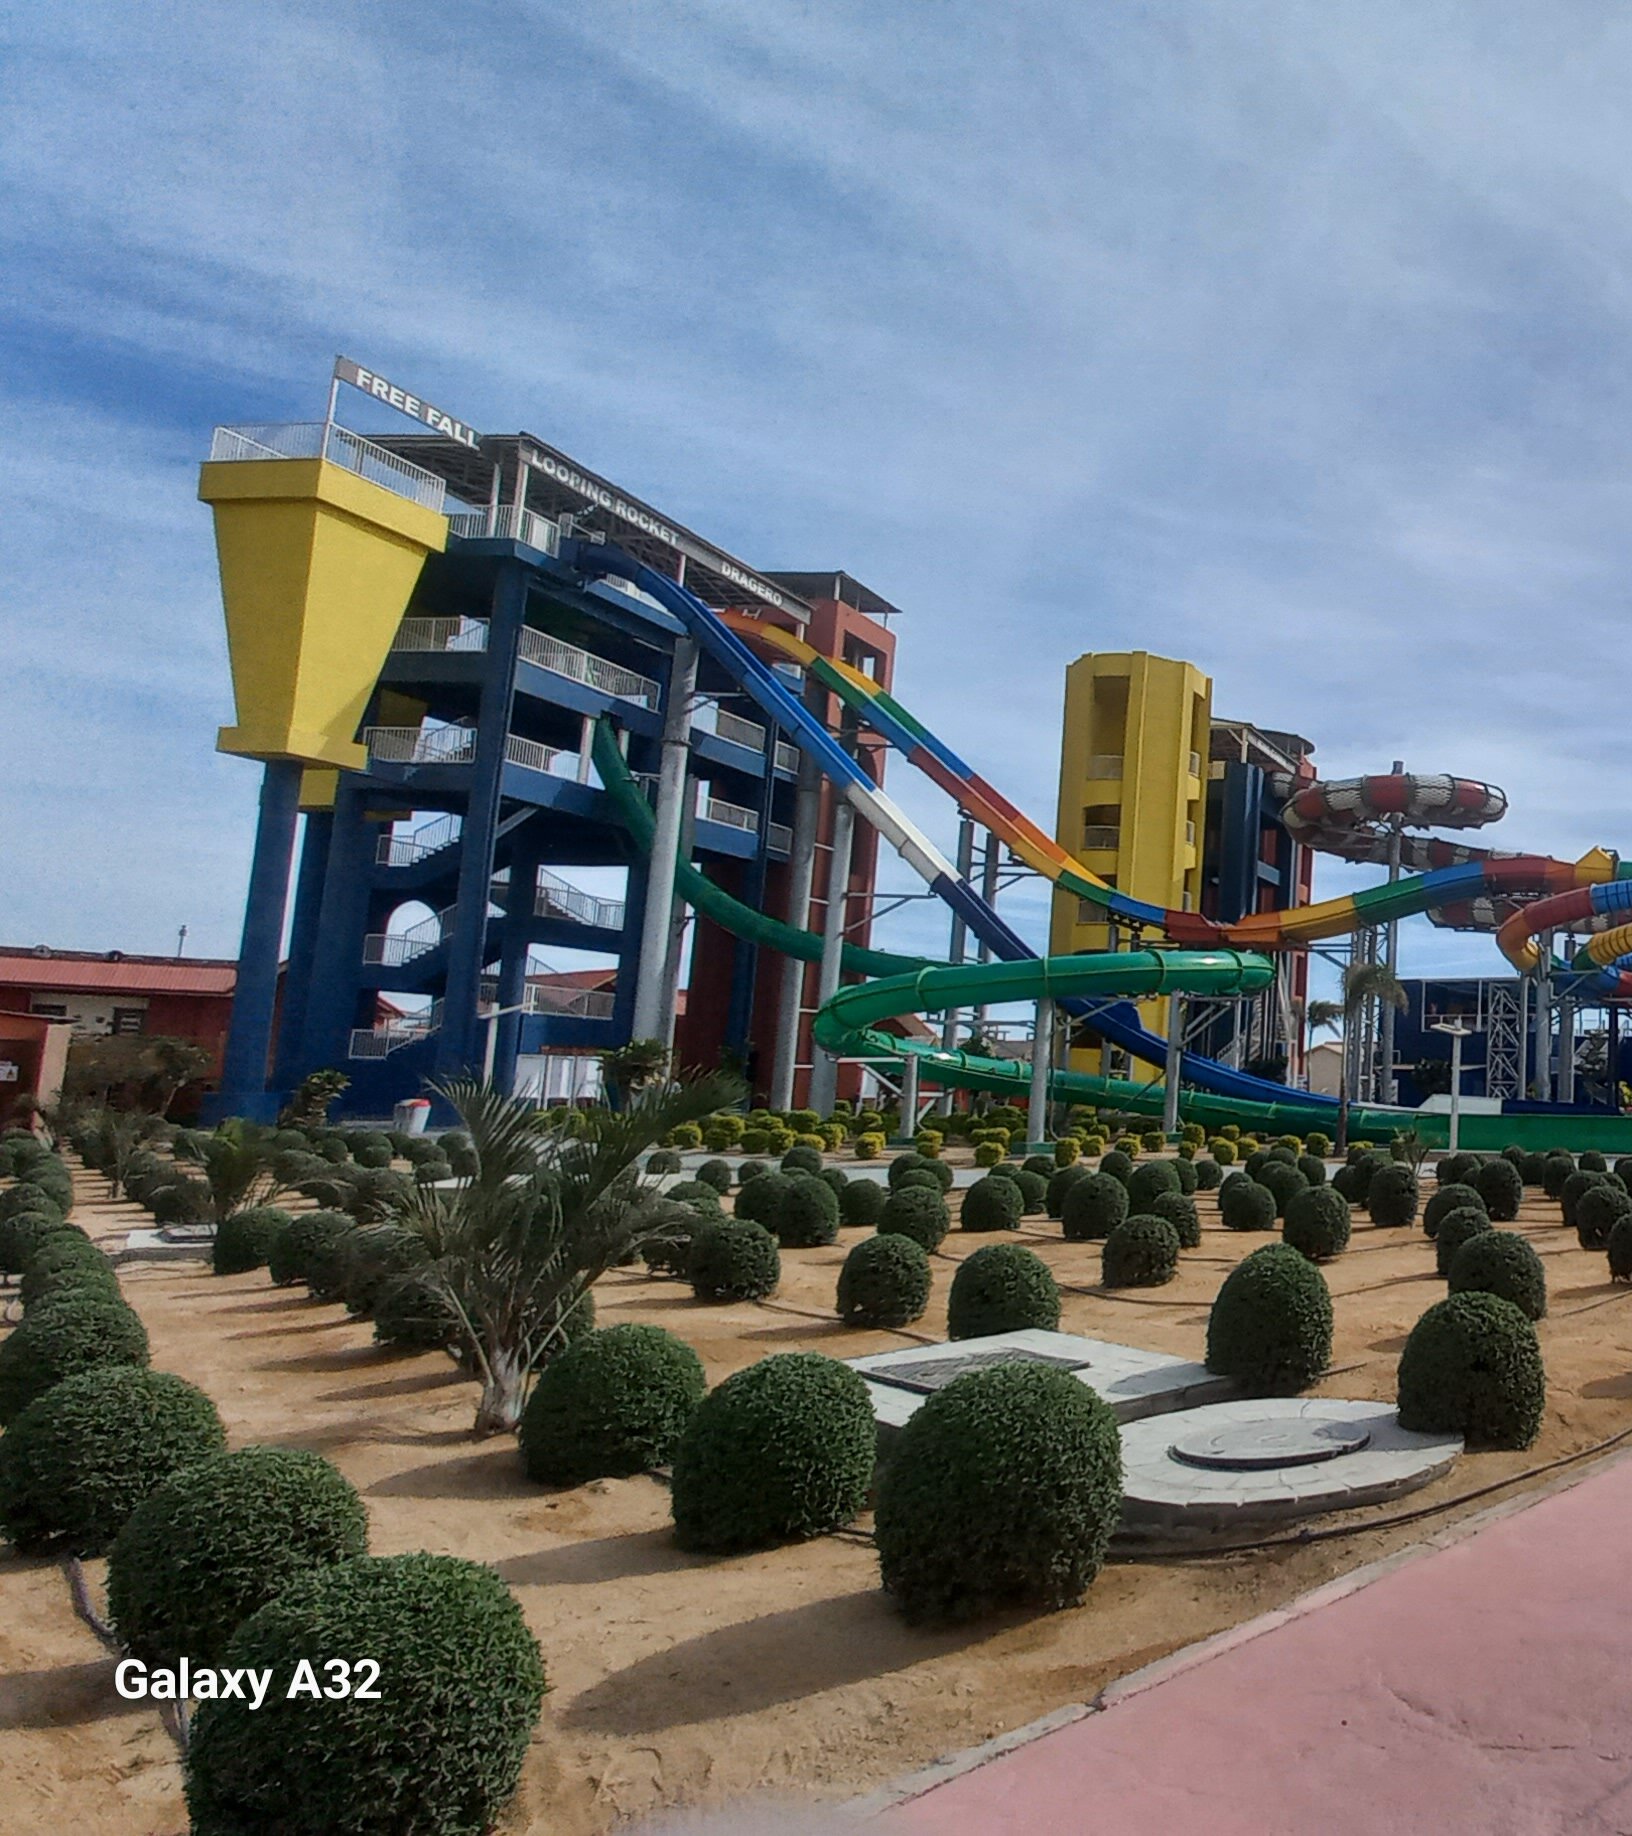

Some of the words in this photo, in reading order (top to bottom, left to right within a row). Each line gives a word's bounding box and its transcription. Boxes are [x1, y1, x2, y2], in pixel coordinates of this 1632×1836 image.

[356, 367, 422, 418] FREE
[425, 406, 481, 451] FALL
[532, 449, 612, 509] LOOPING
[614, 499, 681, 546] ROCKET
[721, 561, 783, 607] DRAGERO
